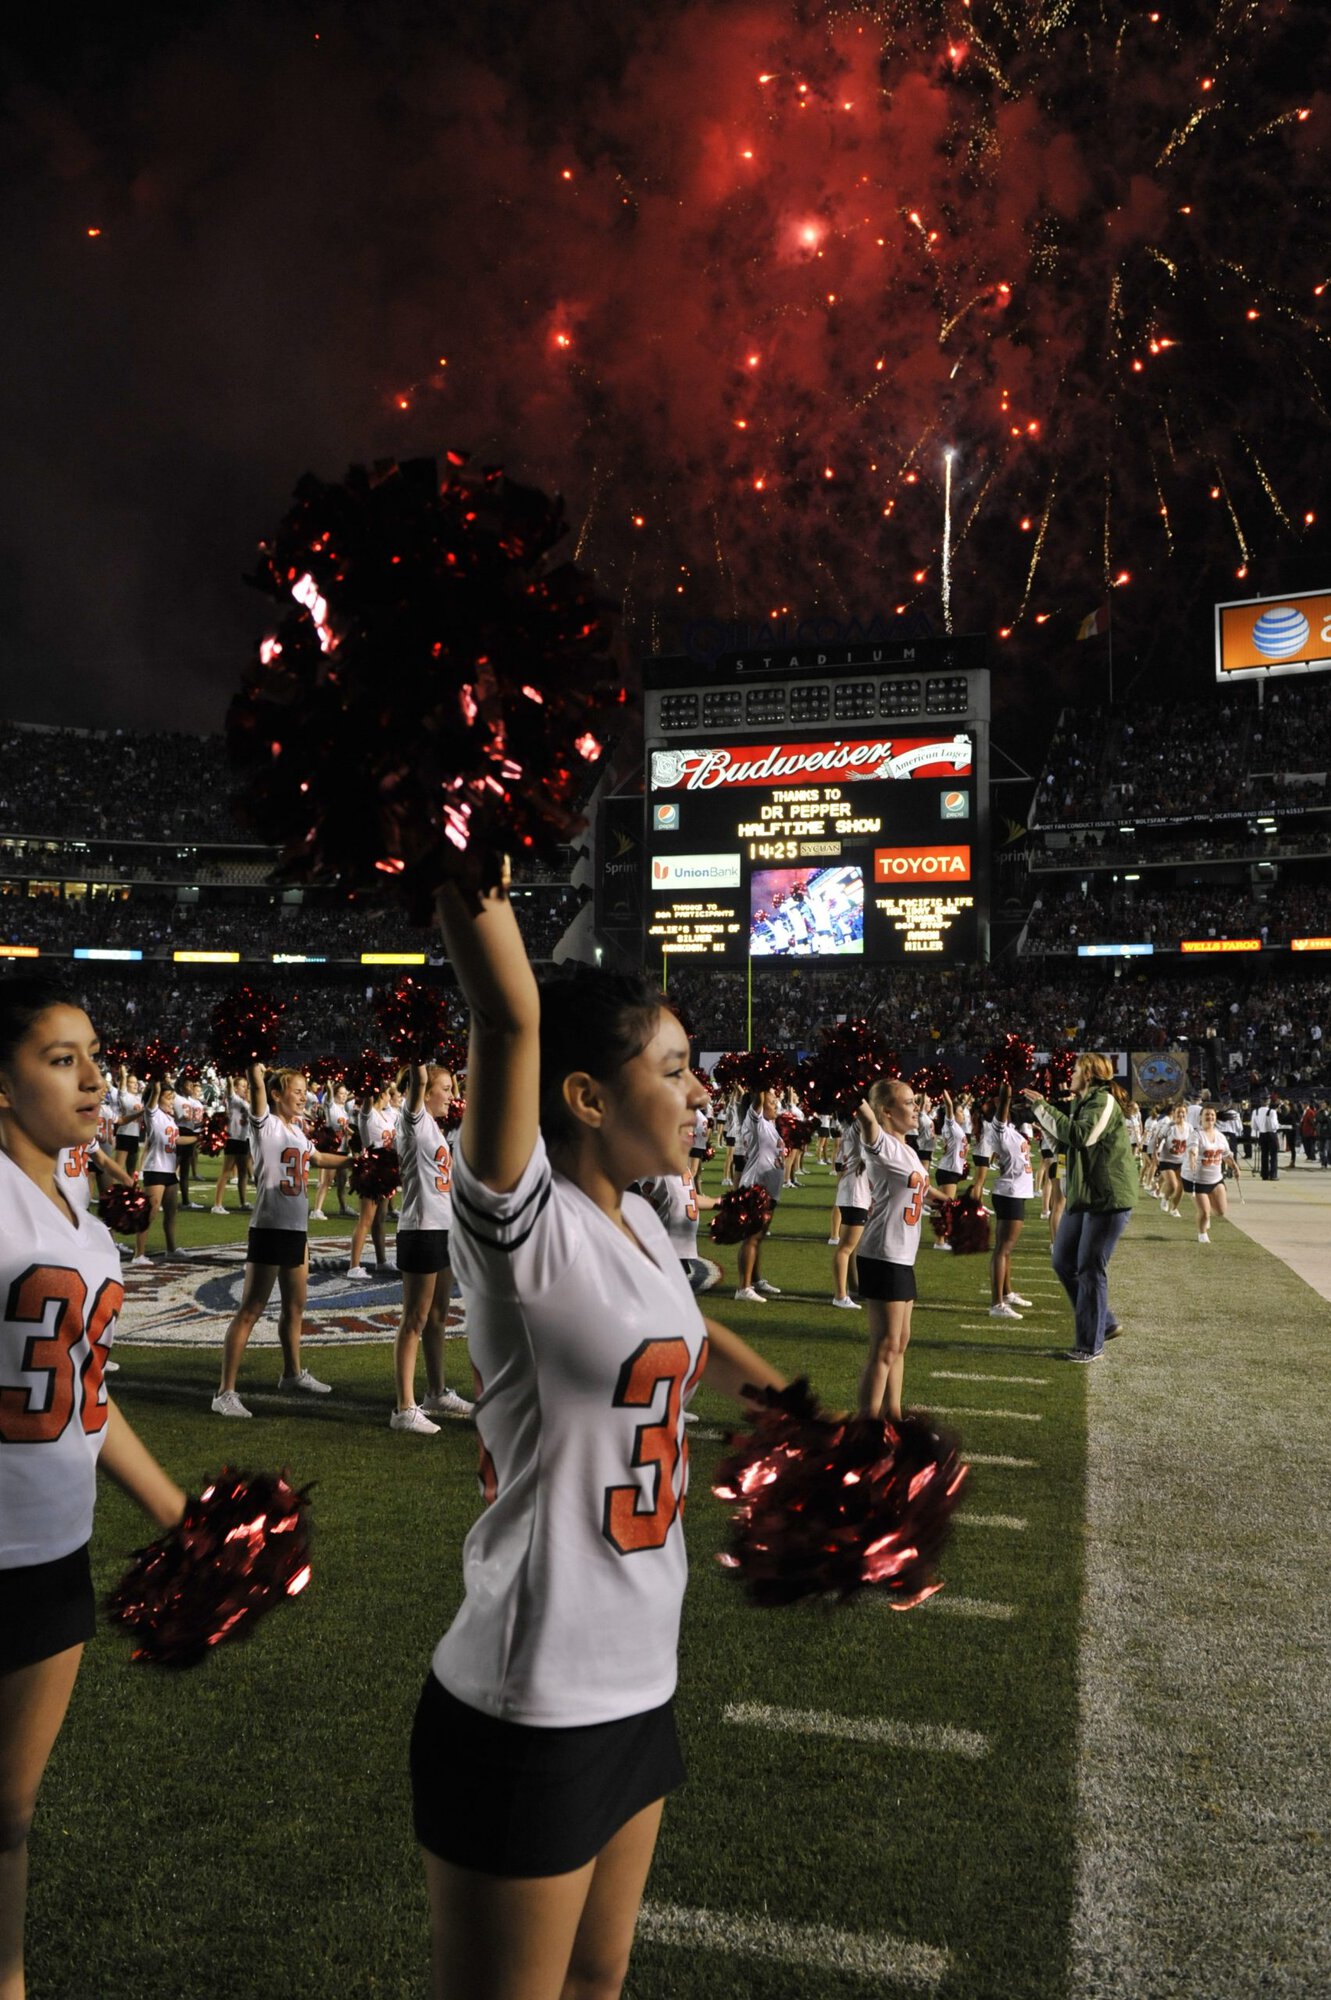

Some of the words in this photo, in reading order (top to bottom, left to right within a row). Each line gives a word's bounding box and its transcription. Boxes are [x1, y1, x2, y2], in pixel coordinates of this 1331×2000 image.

[736, 648, 915, 670] STADIUM
[678, 742, 892, 790] Budweiser
[895, 752, 938, 772] American
[941, 748, 969, 759] Lager
[772, 790, 819, 803] THANKS
[824, 788, 841, 801] TO
[761, 806, 784, 820] DR
[790, 803, 851, 818] PEPPER
[738, 821, 825, 837] HALFTIME
[836, 818, 882, 834] SHOW
[750, 841, 798, 860] 14:25
[674, 866, 738, 878] UnionBank
[879, 856, 965, 874] TOYOTA
[875, 899, 895, 908] THE
[898, 898, 943, 908] PACIFIC
[947, 897, 973, 907] LIFE
[1183, 941, 1221, 951] WELLS
[1222, 940, 1259, 950] FARGO
